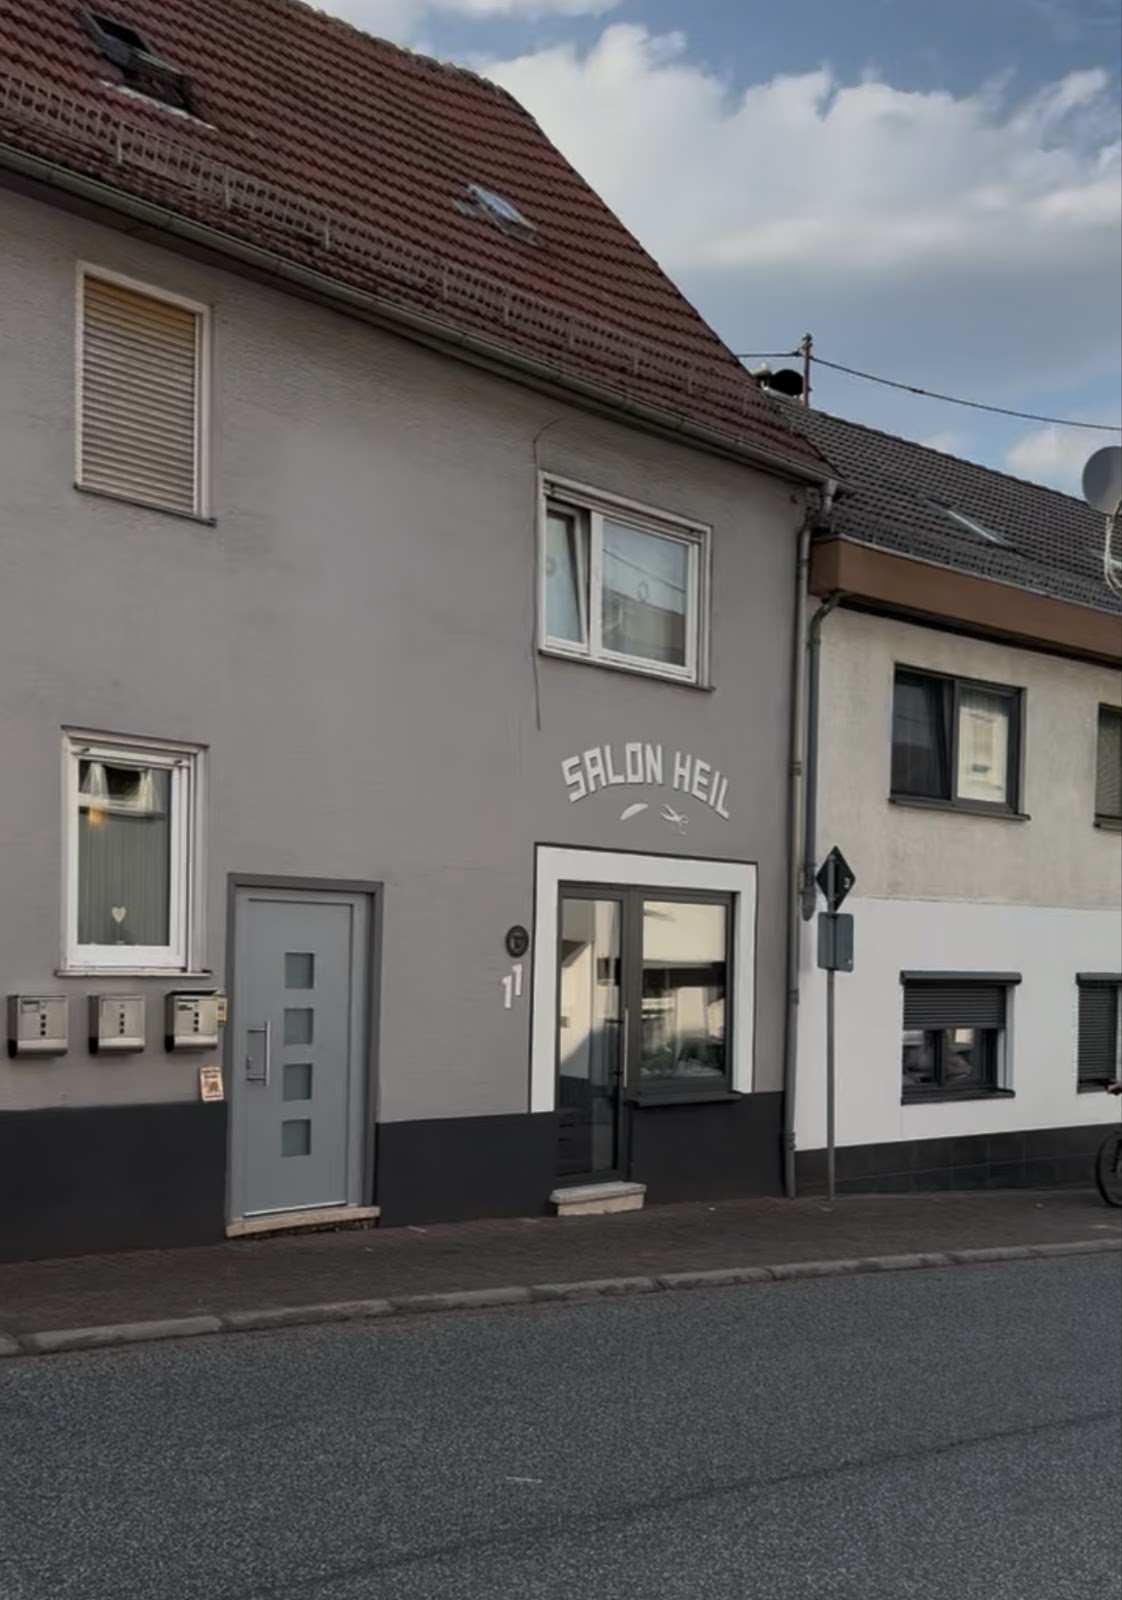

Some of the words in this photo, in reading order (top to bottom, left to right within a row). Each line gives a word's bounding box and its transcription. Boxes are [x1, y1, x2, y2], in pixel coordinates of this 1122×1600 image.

[561, 742, 663, 803] SALON
[673, 751, 730, 819] HEIL
[502, 963, 522, 1009] 11
